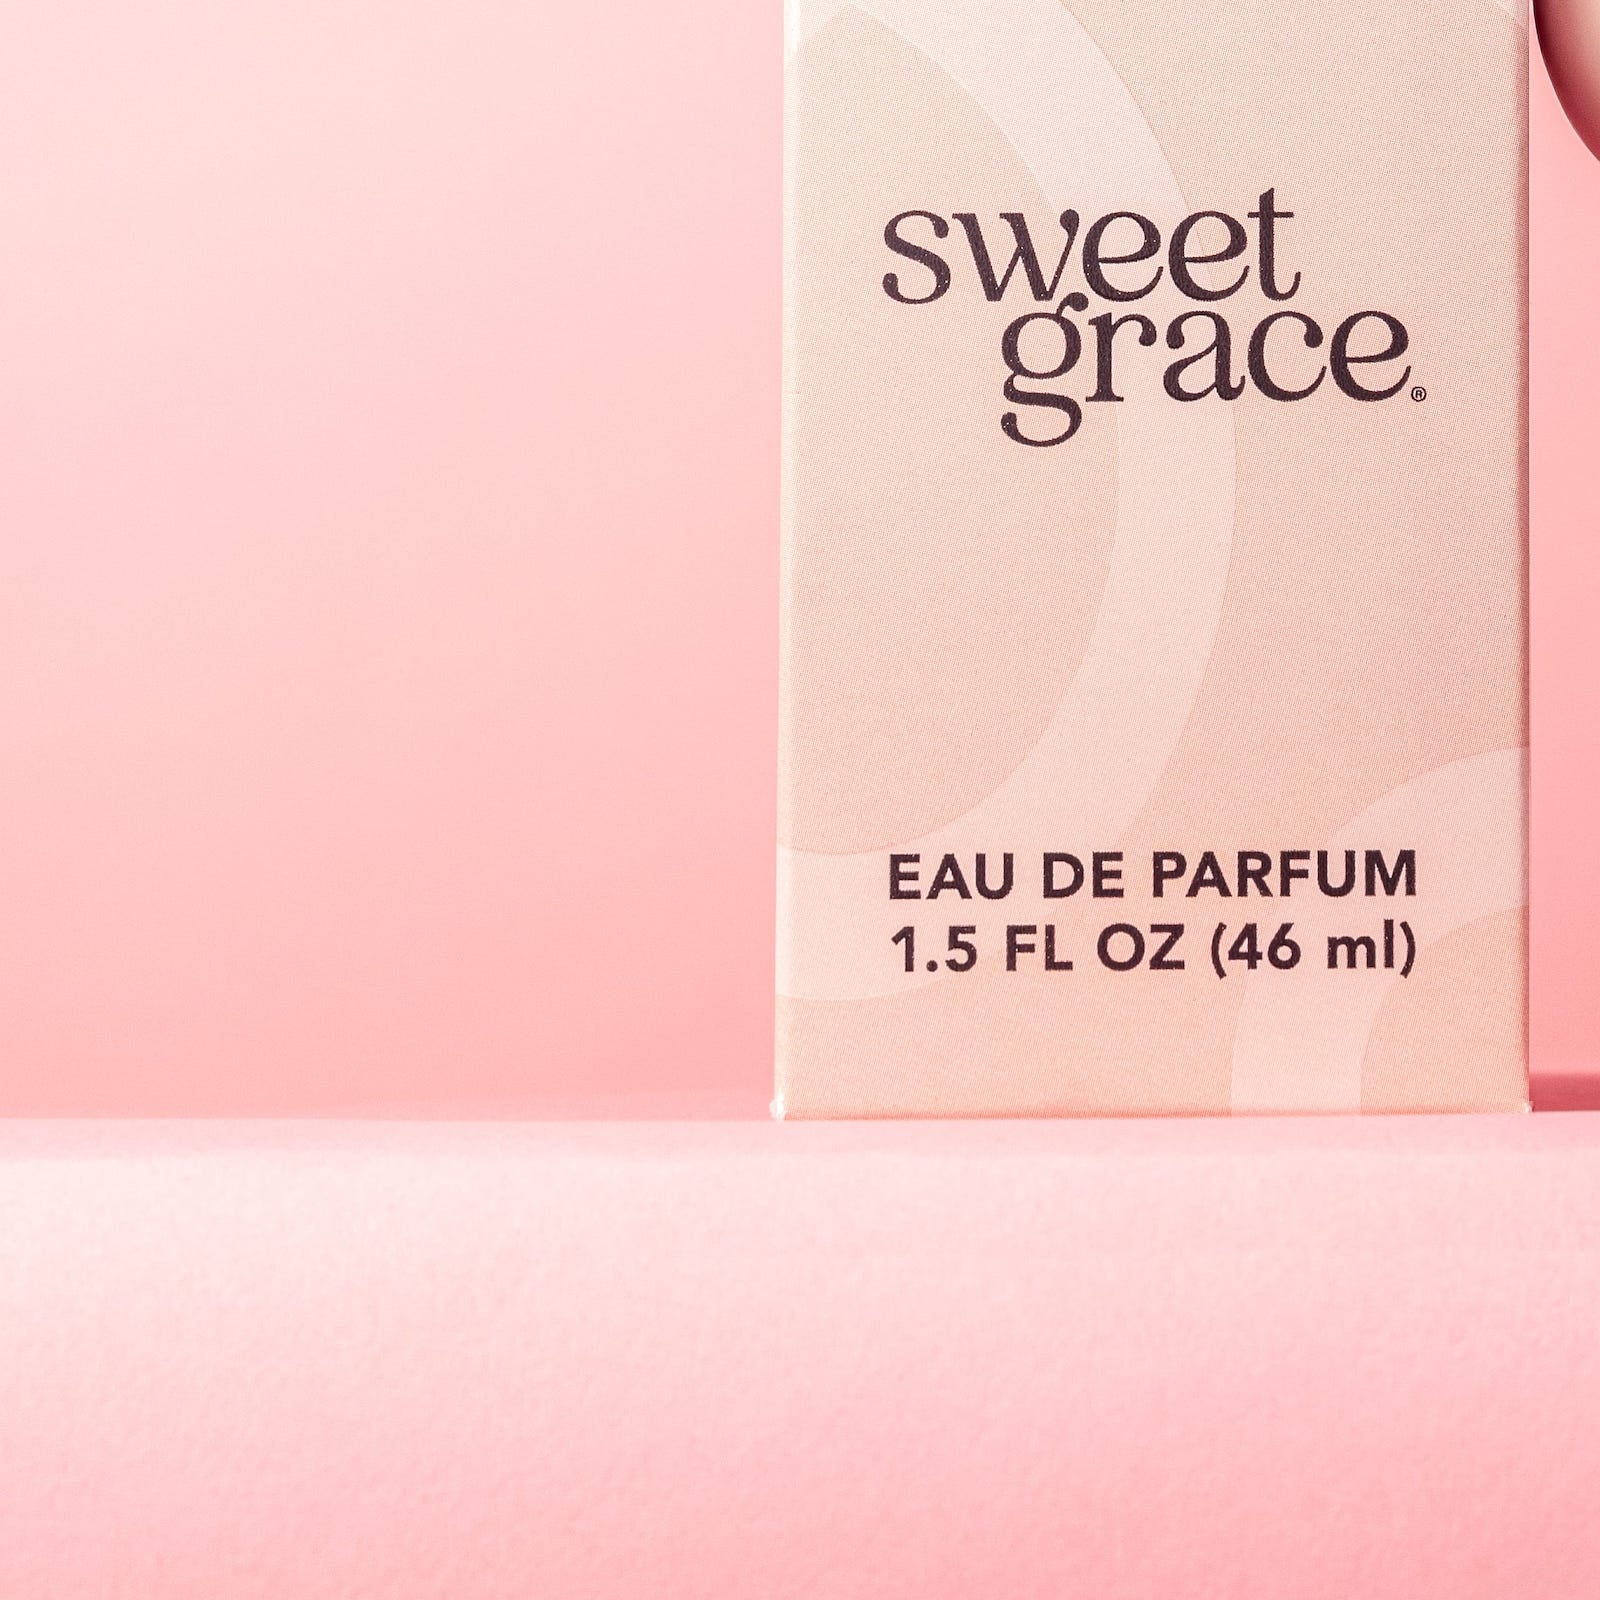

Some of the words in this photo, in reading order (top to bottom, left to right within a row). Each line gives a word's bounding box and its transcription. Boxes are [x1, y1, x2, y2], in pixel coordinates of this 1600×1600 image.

[882, 187, 1302, 305] sweet
[889, 853, 1014, 899] EAU
[1043, 851, 1125, 898] DE
[1152, 849, 1417, 898] PARFUM
[891, 924, 978, 973] 1.5
[1007, 924, 1073, 972] FL
[1097, 923, 1185, 972] OZ
[1210, 921, 1302, 979] (46
[1327, 918, 1417, 979] ml)
